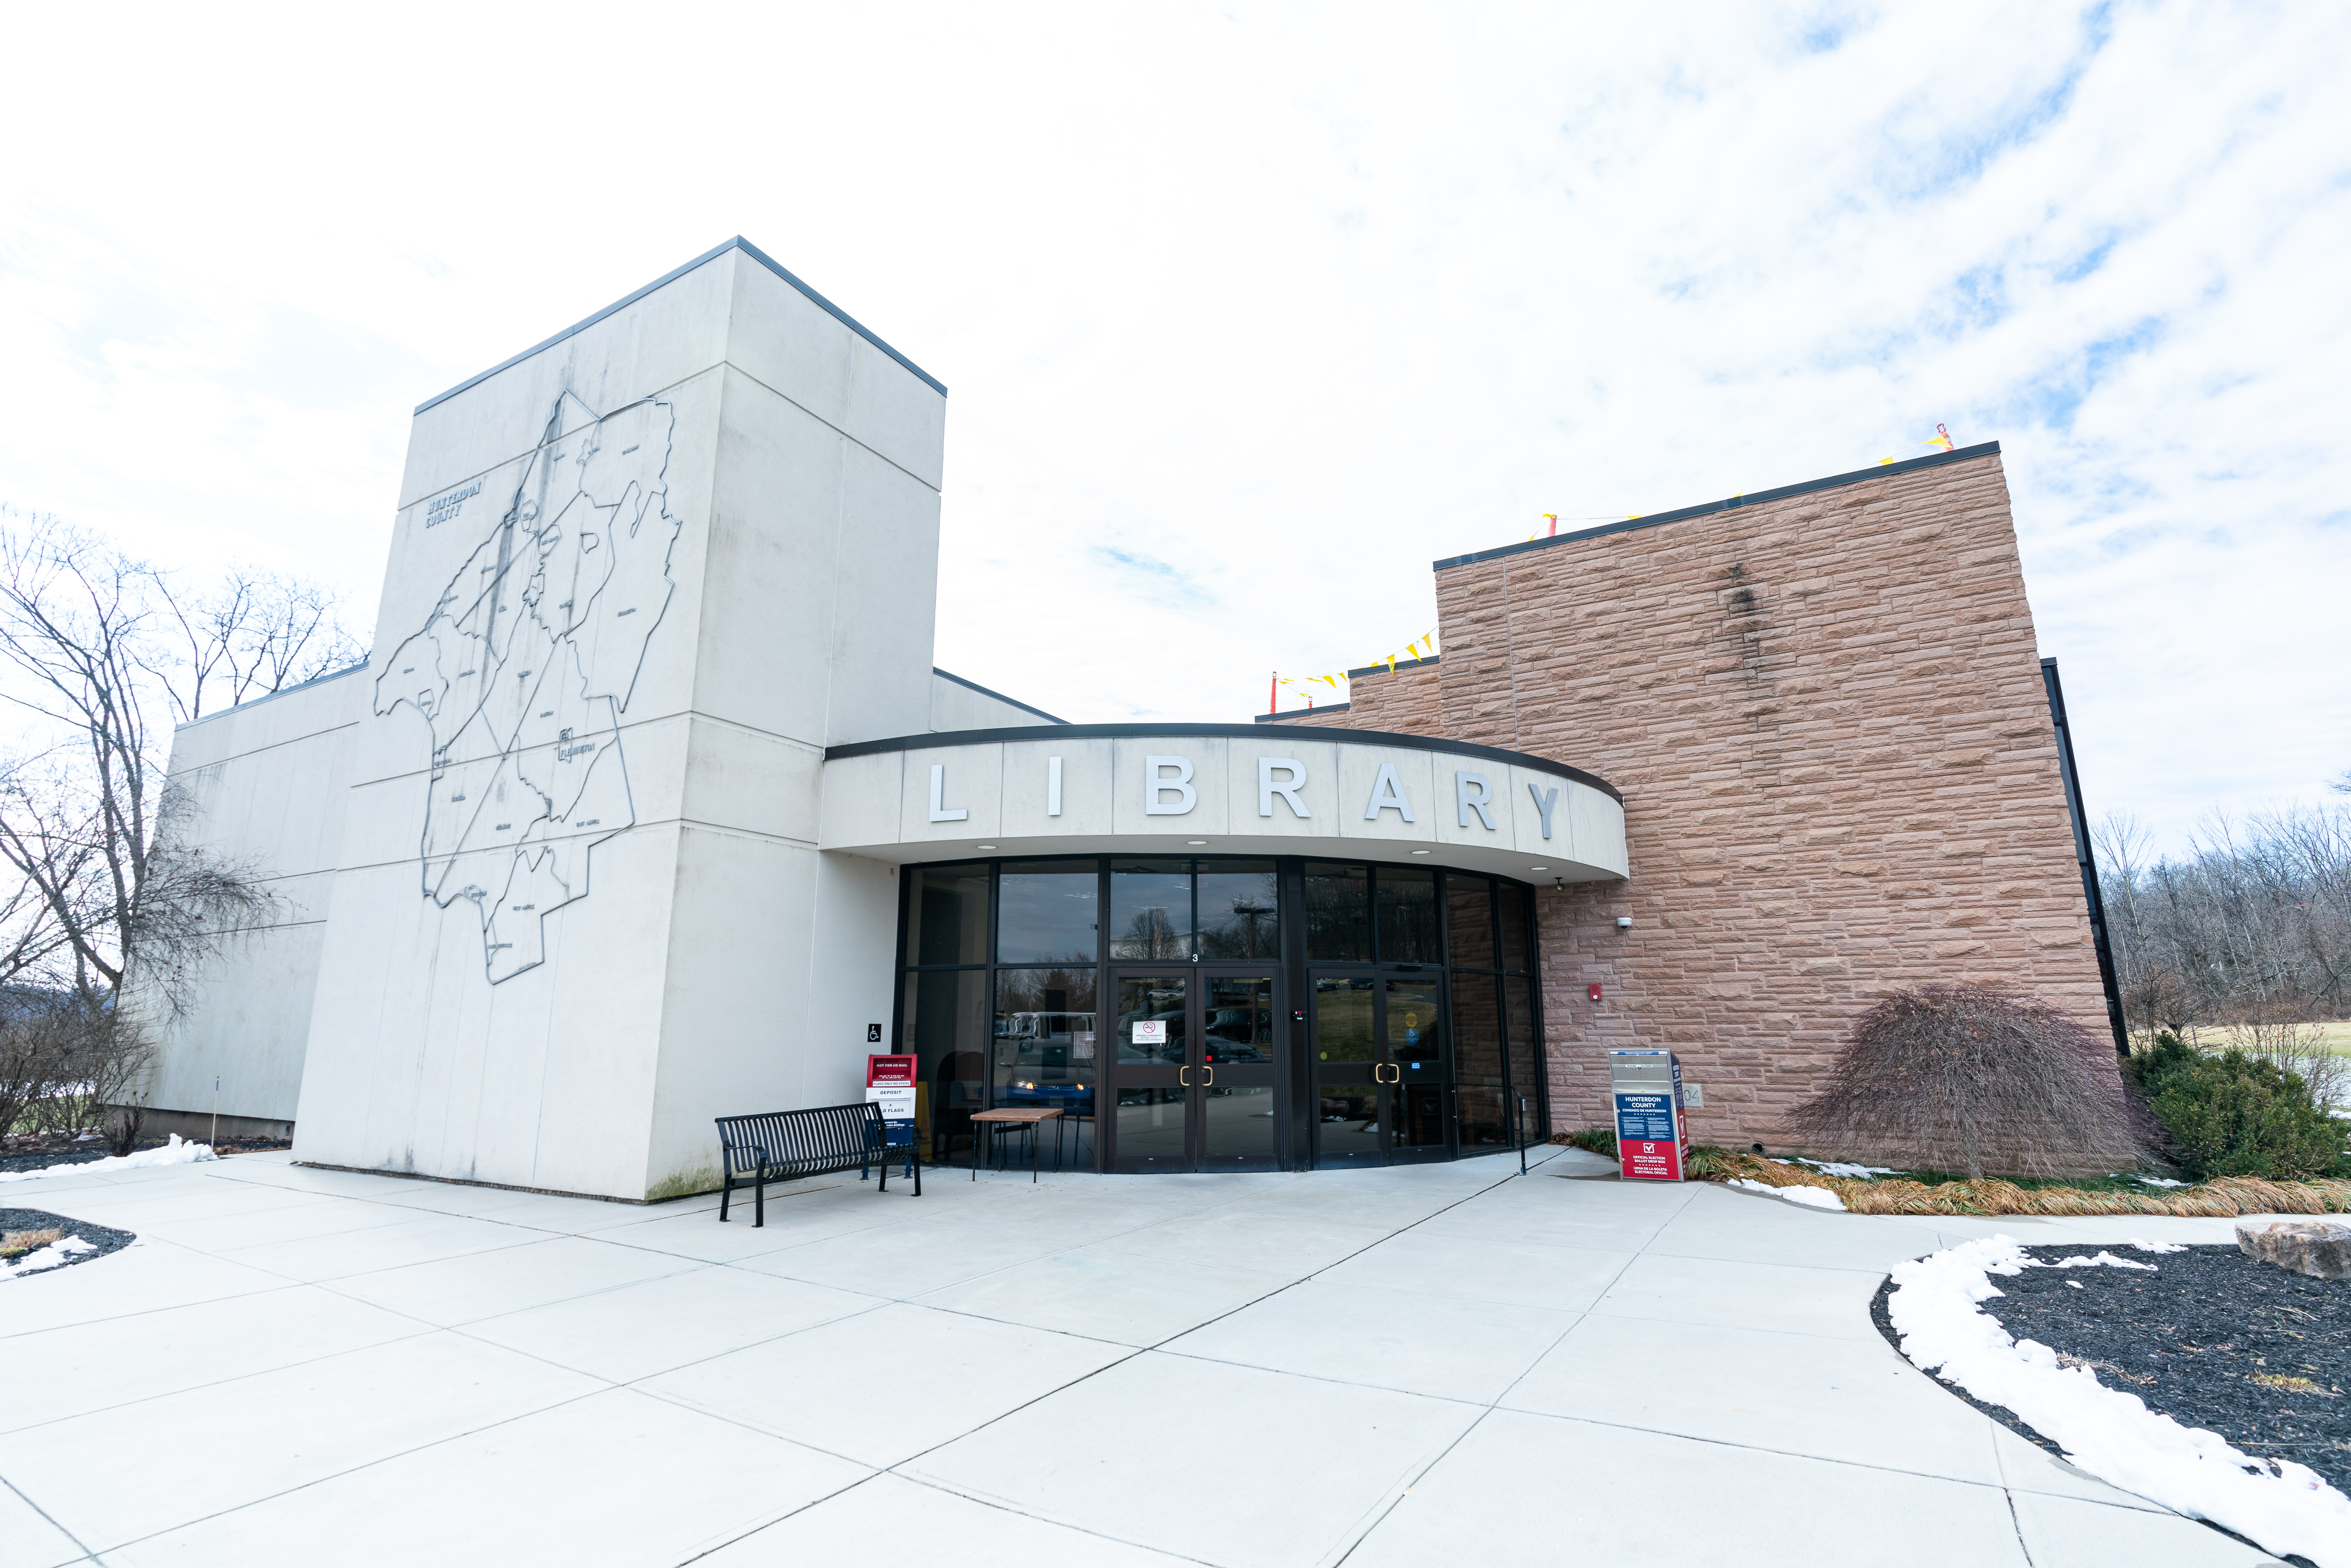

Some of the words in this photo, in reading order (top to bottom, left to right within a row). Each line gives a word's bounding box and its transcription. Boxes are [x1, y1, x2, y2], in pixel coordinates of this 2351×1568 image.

[428, 481, 481, 515] HUNTERDON
[426, 503, 462, 528] COUNTY
[929, 755, 1559, 839] LIBRARY
